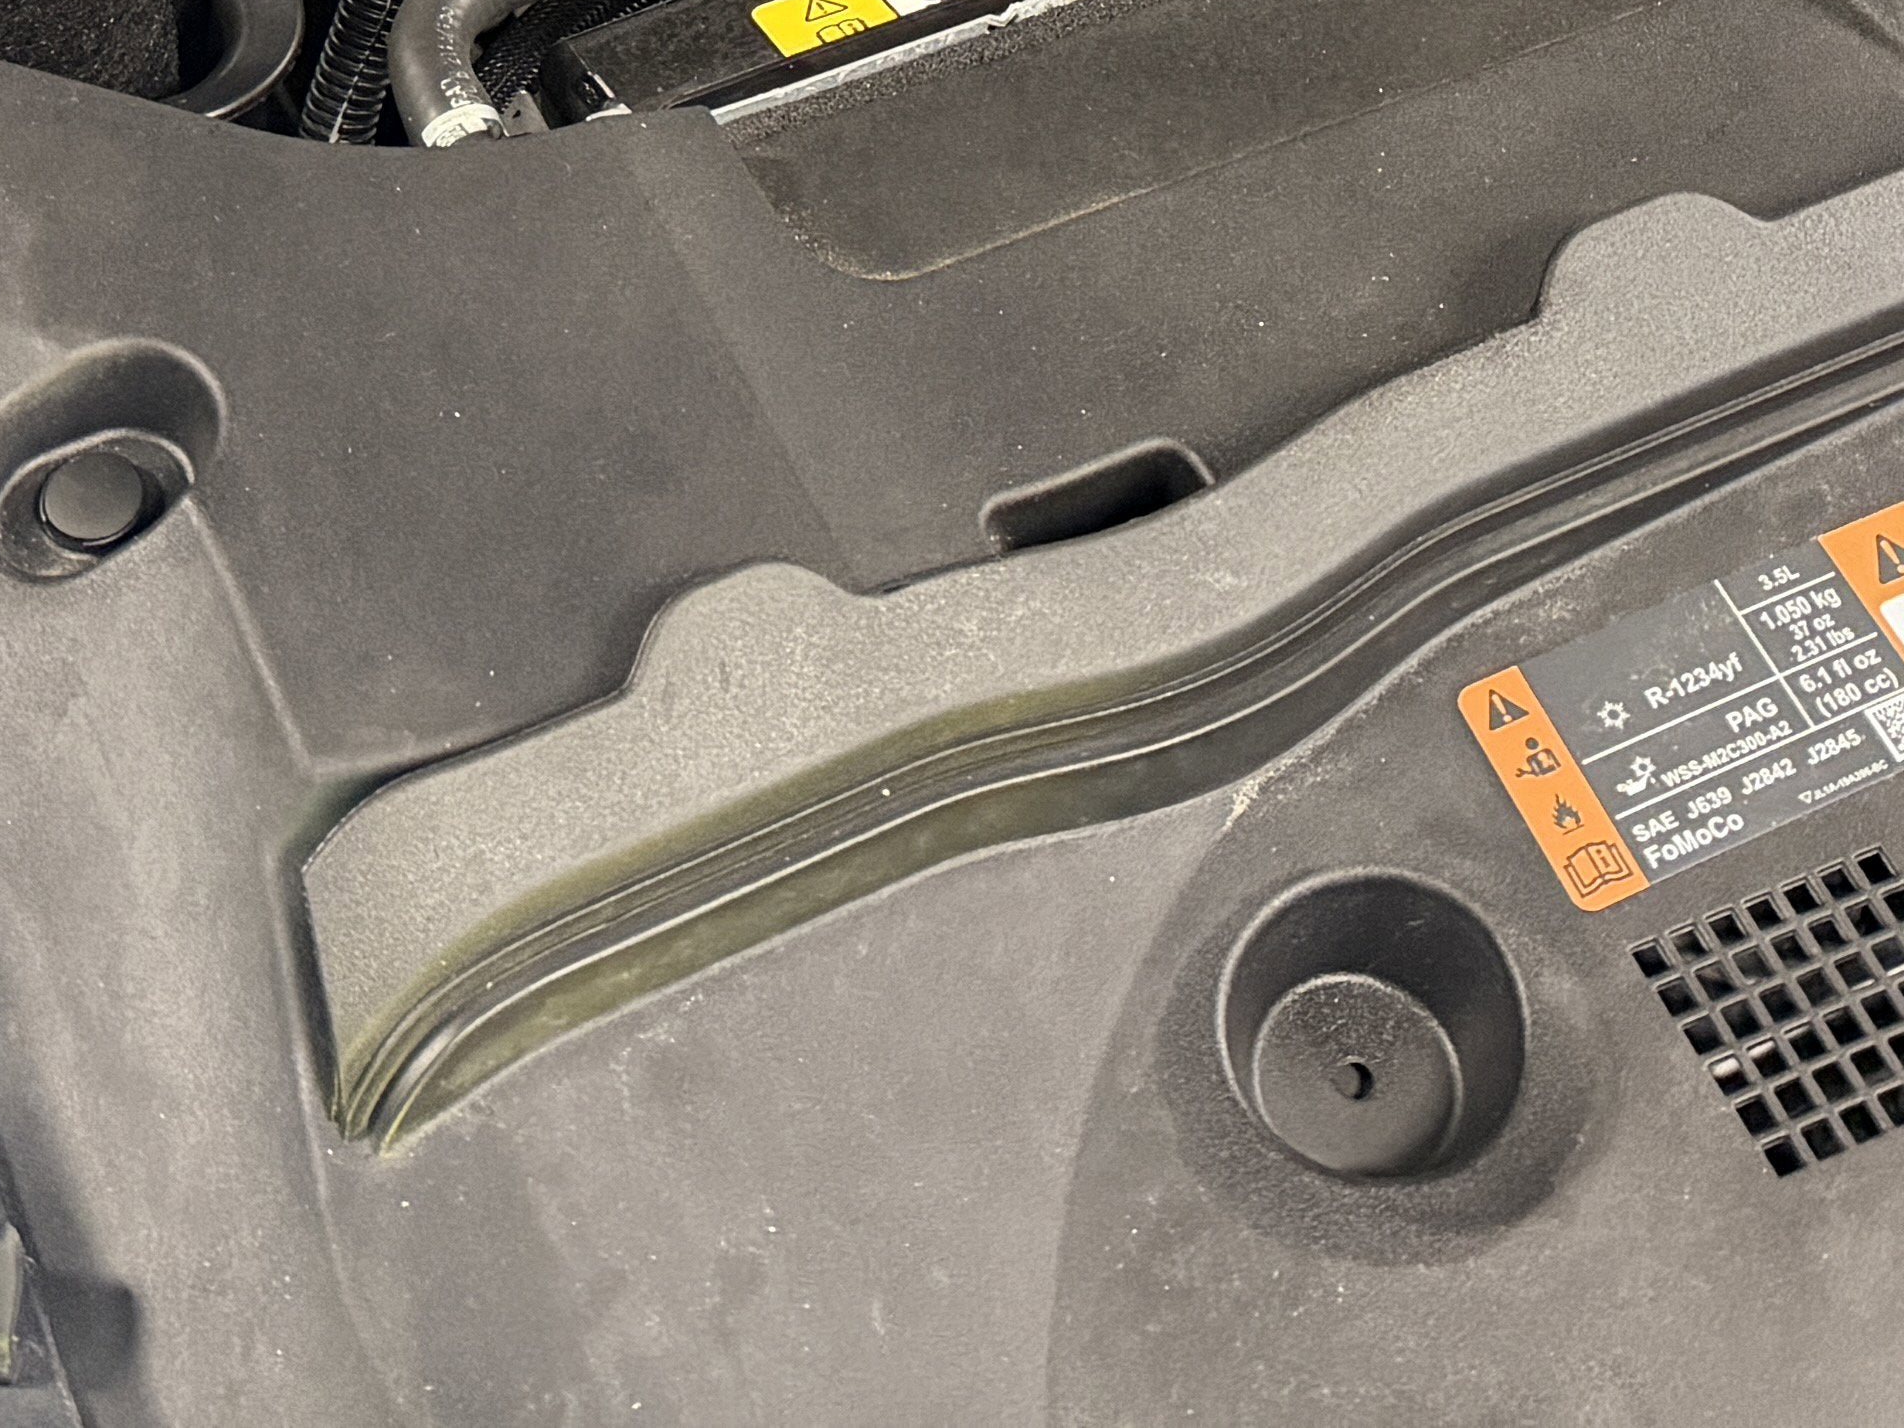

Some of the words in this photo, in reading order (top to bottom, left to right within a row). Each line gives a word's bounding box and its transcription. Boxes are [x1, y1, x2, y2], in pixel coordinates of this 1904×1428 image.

[1758, 565, 1800, 590] 3.5L
[1760, 596, 1812, 629] 1.050
[1809, 588, 1841, 609] kg
[1789, 620, 1810, 640] 37
[1813, 613, 1835, 630] oz
[1791, 636, 1827, 662] 2.31
[1826, 627, 1855, 646] lbs
[1644, 652, 1742, 709] R-1234yf
[1799, 666, 1832, 692] 6.1
[1833, 657, 1852, 678] fl
[1853, 649, 1881, 669] oz
[1815, 682, 1862, 718] (180
[1864, 667, 1899, 694] cc)
[1725, 697, 1778, 733] PAG
[1660, 720, 1792, 787] WSS-M2C300-A2
[1632, 810, 1679, 842] SAE
[1687, 787, 1732, 819] J639
[1742, 758, 1796, 795] J2842
[1808, 728, 1861, 765] J2845
[1643, 814, 1744, 869] FoMoCo
